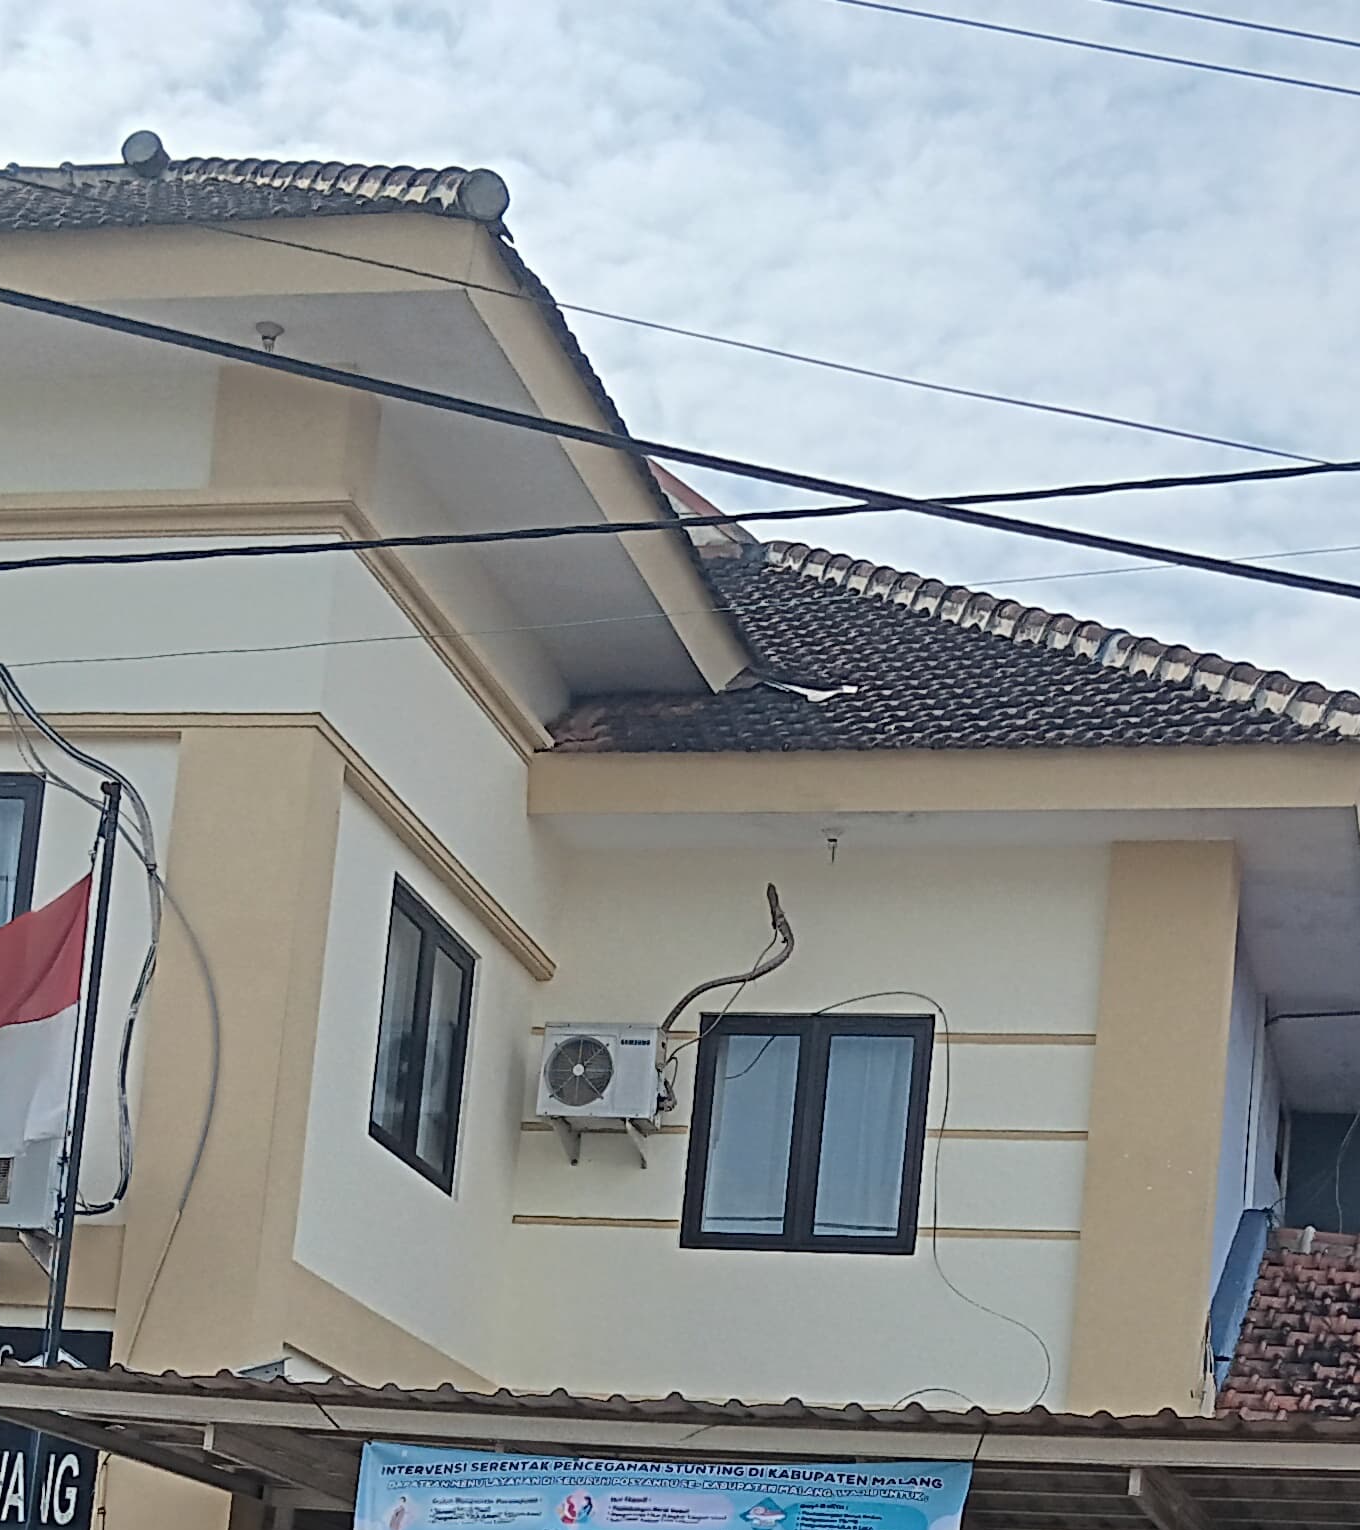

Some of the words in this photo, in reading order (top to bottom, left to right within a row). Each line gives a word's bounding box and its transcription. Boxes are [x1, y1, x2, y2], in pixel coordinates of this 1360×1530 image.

[381, 1463, 469, 1476] INTERVENSI
[471, 1461, 549, 1473] SERENTAK
[553, 1461, 664, 1474] PENCEGAHAN
[665, 1464, 744, 1477] STUNTING
[748, 1467, 765, 1478] DI
[768, 1469, 869, 1486] KABUPATEN
[872, 1476, 943, 1489] MALANG
